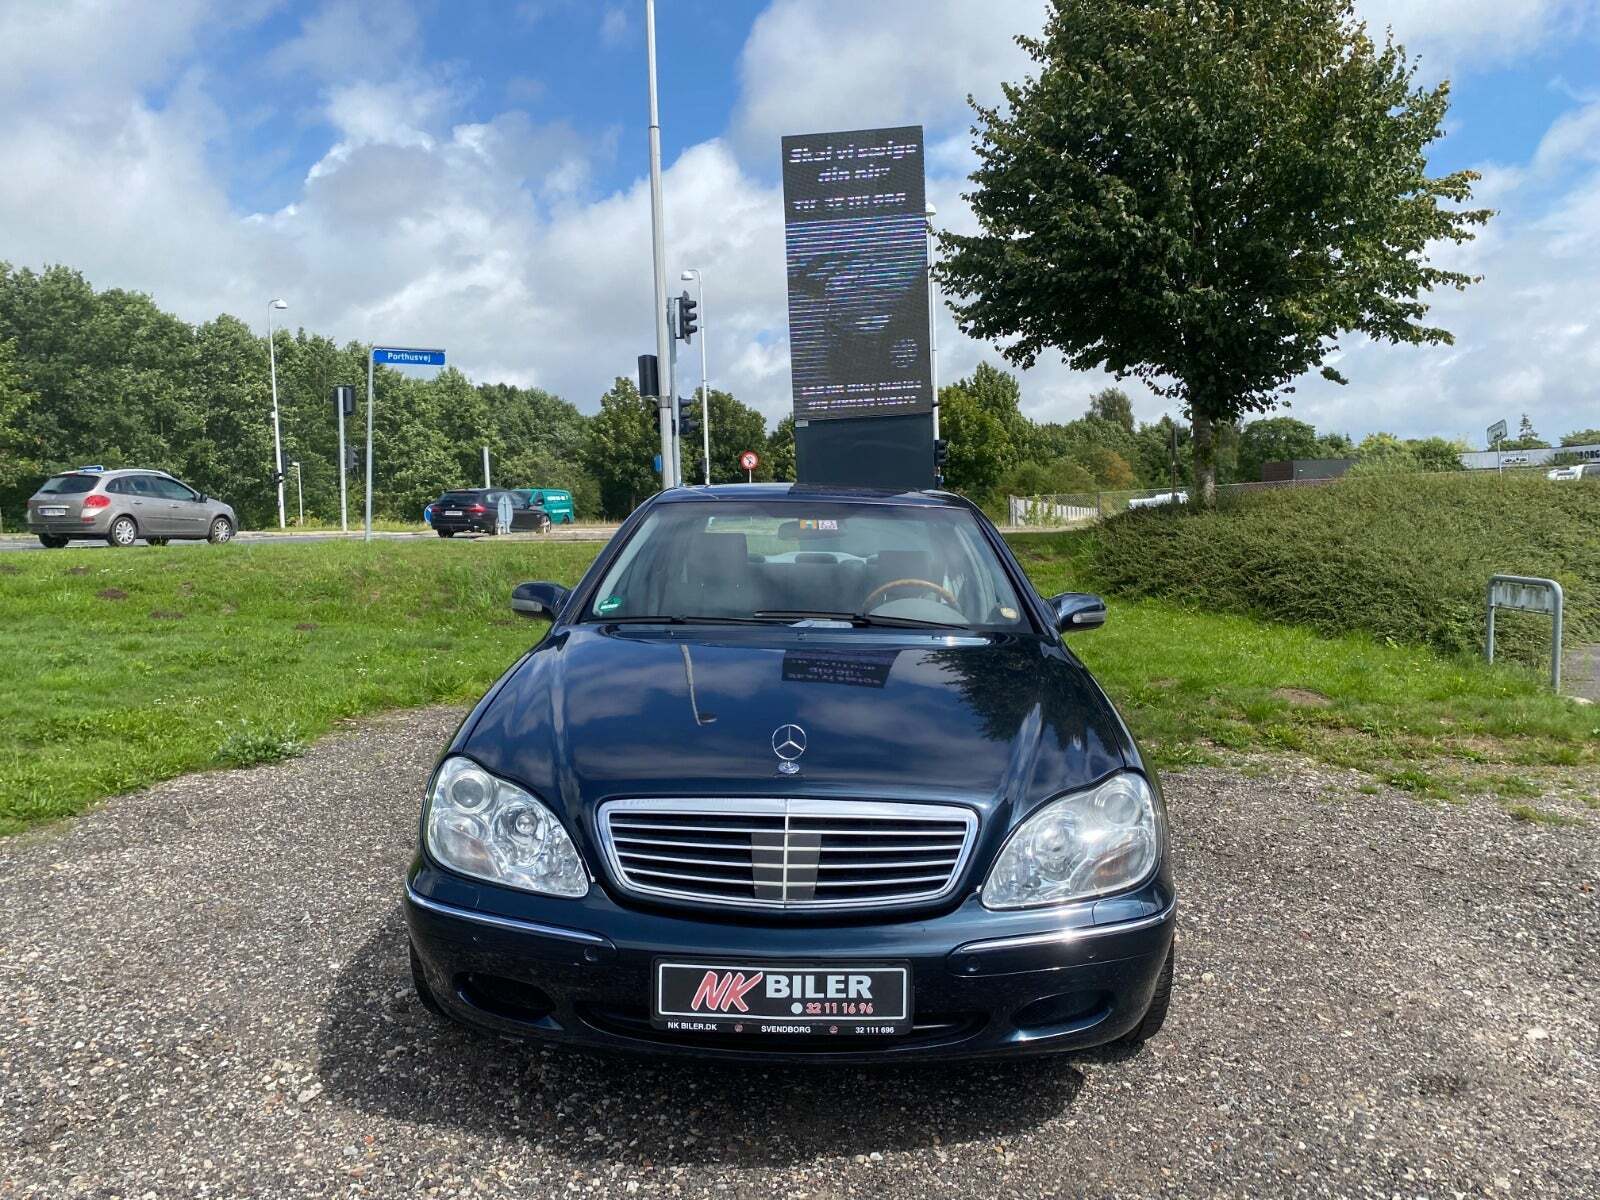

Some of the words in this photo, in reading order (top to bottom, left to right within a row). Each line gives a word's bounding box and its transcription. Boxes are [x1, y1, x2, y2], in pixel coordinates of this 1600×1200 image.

[387, 352, 431, 363] Porthusvej
[690, 970, 763, 1013] NK
[765, 974, 872, 999] BILER
[806, 1002, 822, 1014] 32
[824, 1002, 837, 1014] 11
[841, 1002, 856, 1014] 16
[858, 1002, 874, 1014] 96
[667, 1022, 679, 1030] NK
[681, 1022, 717, 1031] BILER.DK
[761, 1025, 811, 1033] SVENDBORG
[855, 1026, 865, 1034] 32
[866, 1026, 879, 1034] 111
[881, 1026, 894, 1034] 696
